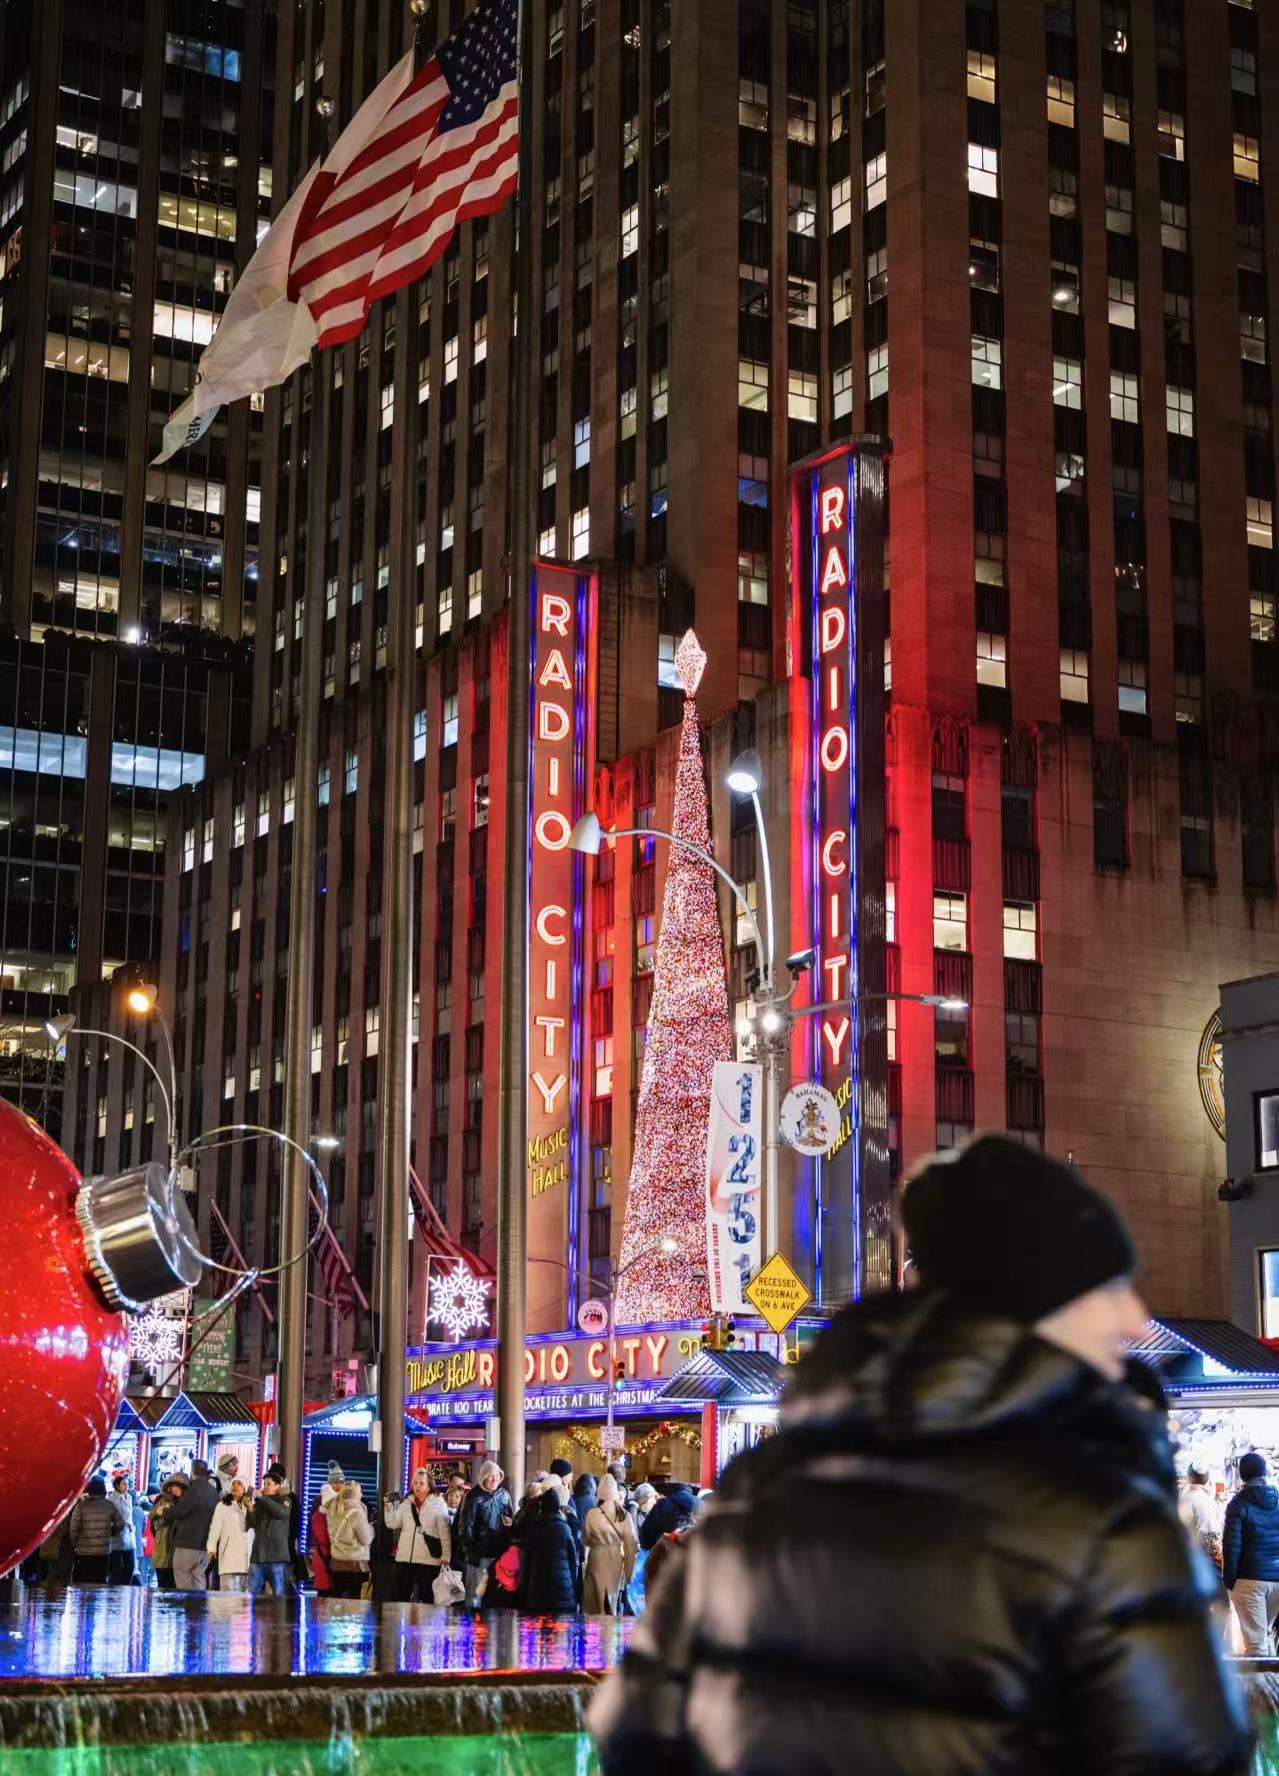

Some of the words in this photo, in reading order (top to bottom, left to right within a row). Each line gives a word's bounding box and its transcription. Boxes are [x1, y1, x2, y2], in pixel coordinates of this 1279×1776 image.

[821, 486, 848, 772] RADIO
[534, 594, 572, 851] RADIO
[821, 830, 849, 1066] CITY
[531, 904, 567, 1114] CITY
[835, 1077, 853, 1110] SIC
[528, 1128, 568, 1168] MUSIC
[532, 1161, 567, 1197] HALL
[726, 1072, 757, 1305] 1251
[755, 1288, 800, 1300] CROSSWALK
[758, 1277, 797, 1288] RECESSED
[760, 1300, 771, 1309] ON
[773, 1301, 778, 1310] 6
[781, 1301, 796, 1311] AVE
[406, 1360, 444, 1394] Music
[441, 1349, 476, 1393] Hall
[479, 1345, 569, 1387] RDIO
[409, 1402, 450, 1416] BRATE
[454, 1401, 470, 1414] 100
[523, 1393, 567, 1411] OCKETTES
[571, 1392, 584, 1408] AT
[589, 1390, 605, 1407] THE
[612, 1388, 657, 1406] CHRISTMA
[447, 1442, 471, 1451] Subway
